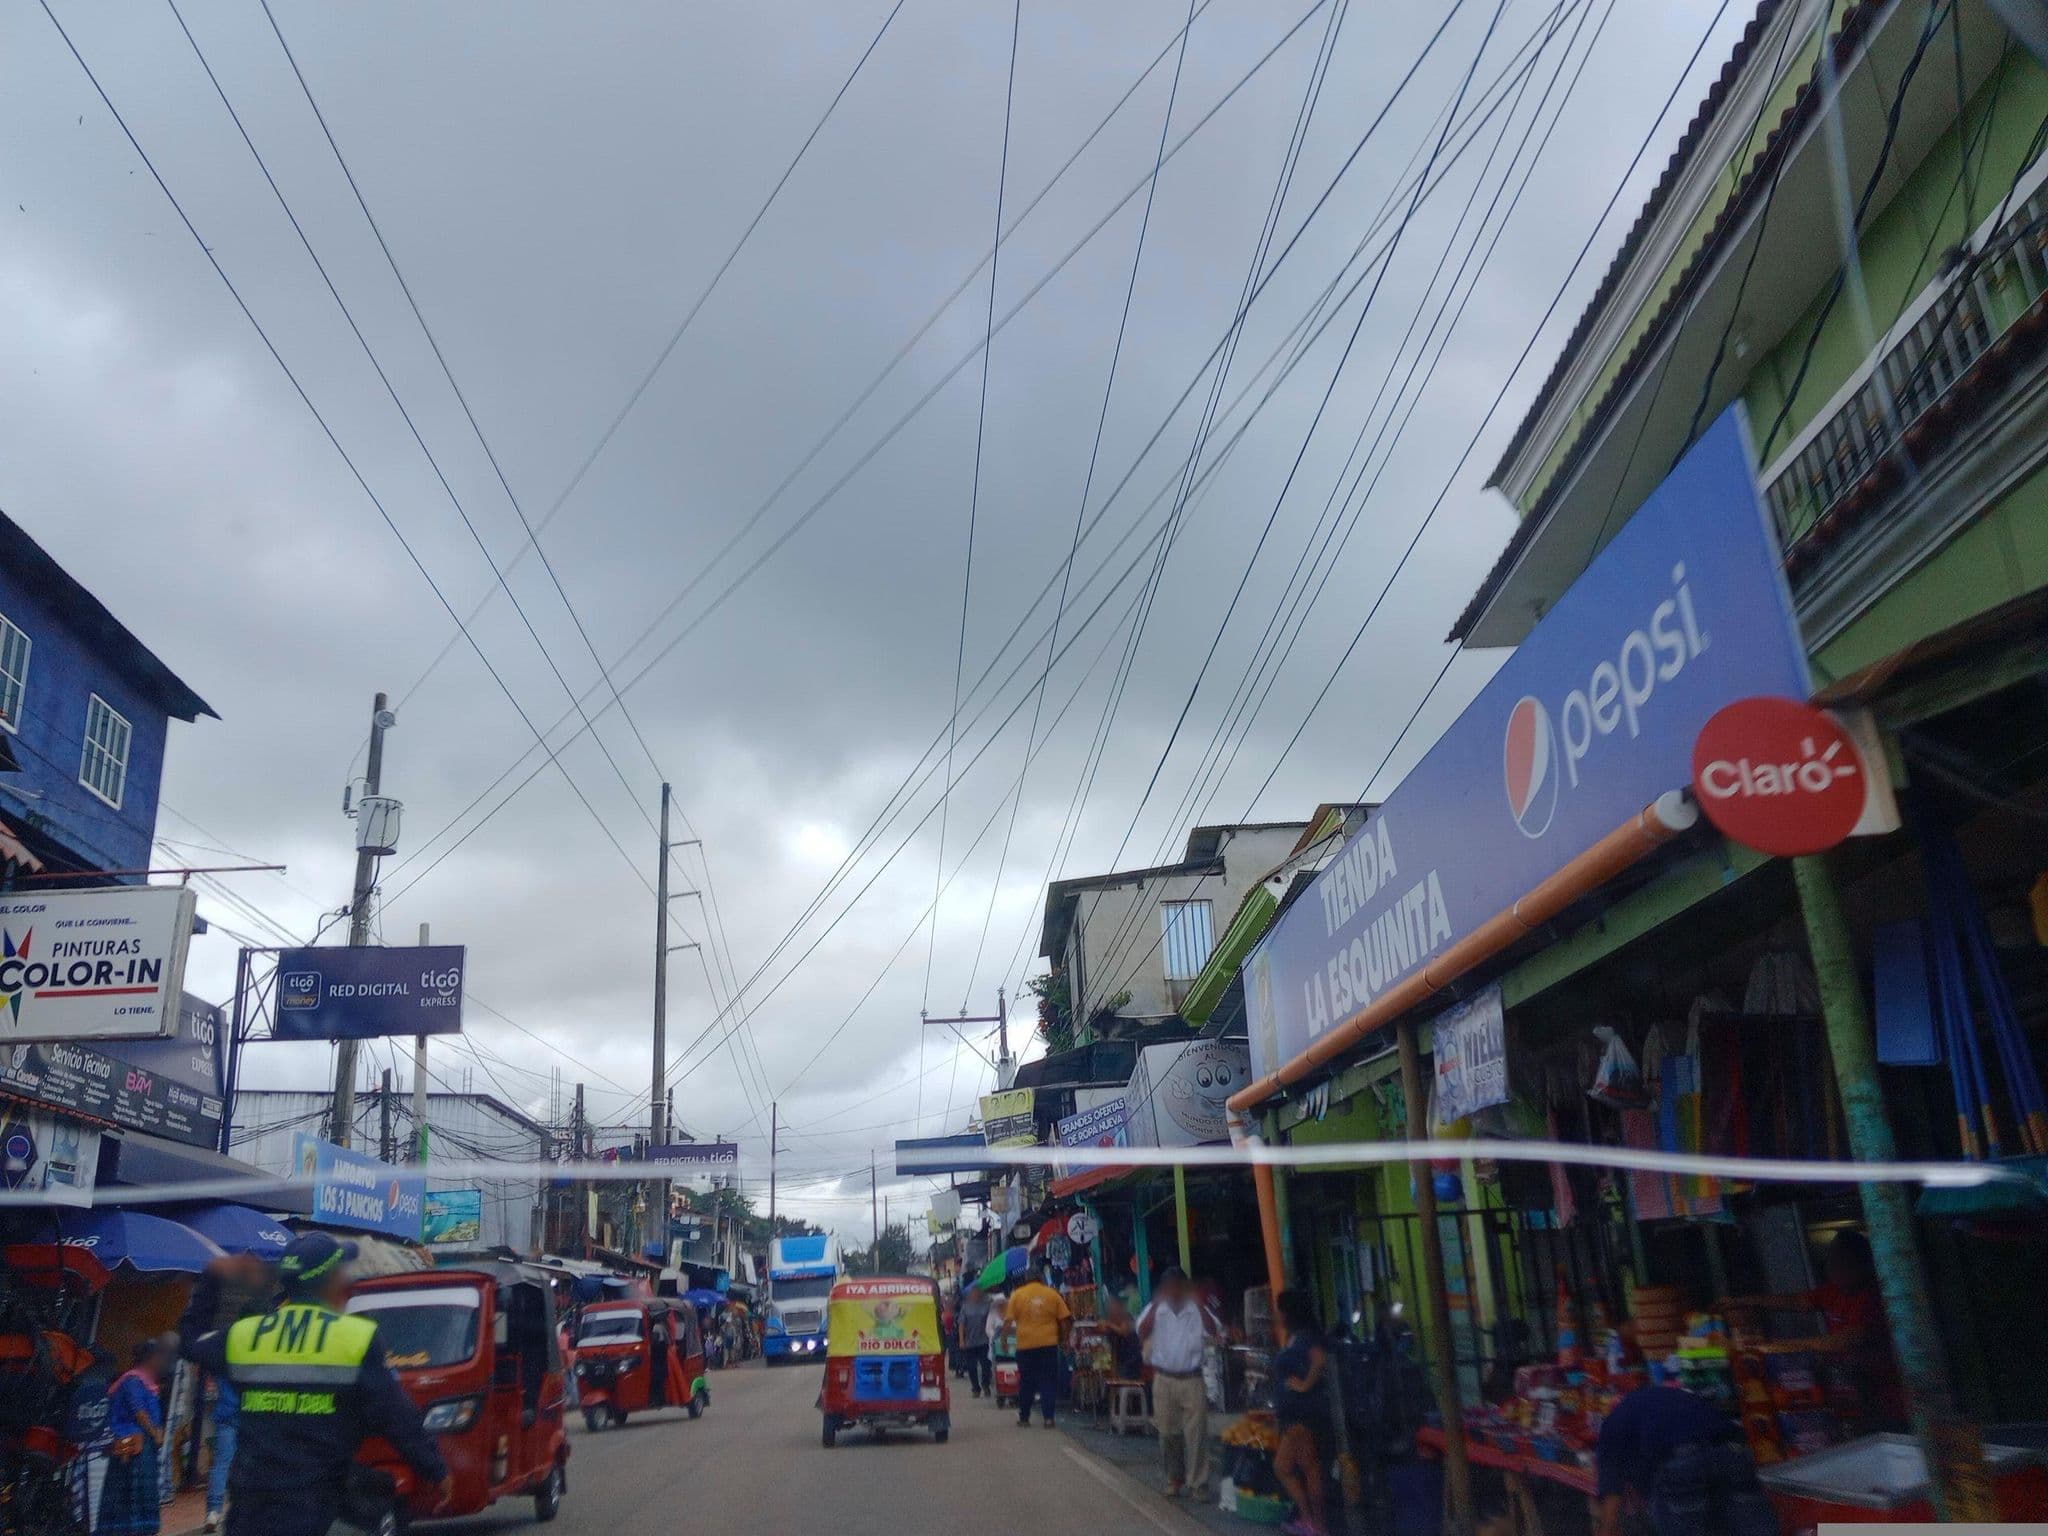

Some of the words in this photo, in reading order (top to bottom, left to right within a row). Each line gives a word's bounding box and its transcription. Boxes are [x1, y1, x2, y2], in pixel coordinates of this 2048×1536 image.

[1562, 560, 1701, 788] pepsi
[1702, 754, 1834, 798] Claro
[1319, 815, 1398, 938] TIENDA
[13, 904, 47, 914] COLOR
[52, 939, 141, 957] PINTURAS
[1304, 971, 1330, 1038] LA
[1327, 869, 1452, 1020] ESQUINITA
[0, 958, 162, 993] COLOR-IN
[329, 984, 355, 997] RED
[358, 983, 410, 997] DIGITAL
[421, 968, 459, 991] tigo
[114, 1007, 126, 1015] LO
[420, 997, 457, 1007] EXPRESS
[51, 1043, 82, 1070] Servicio
[83, 1053, 111, 1078] Técnico
[1060, 1114, 1093, 1136] GRANDES
[1094, 1099, 1126, 1121] OFERTAS
[1067, 1133, 1079, 1147] DE
[1079, 1126, 1099, 1144] ROPA
[1099, 1115, 1124, 1135] NUEVA
[654, 1157, 669, 1166] RED
[319, 1184, 337, 1213] LOS
[338, 1189, 345, 1214] 3
[345, 1191, 384, 1223] PANCHOS
[250, 1309, 340, 1353] PMT
